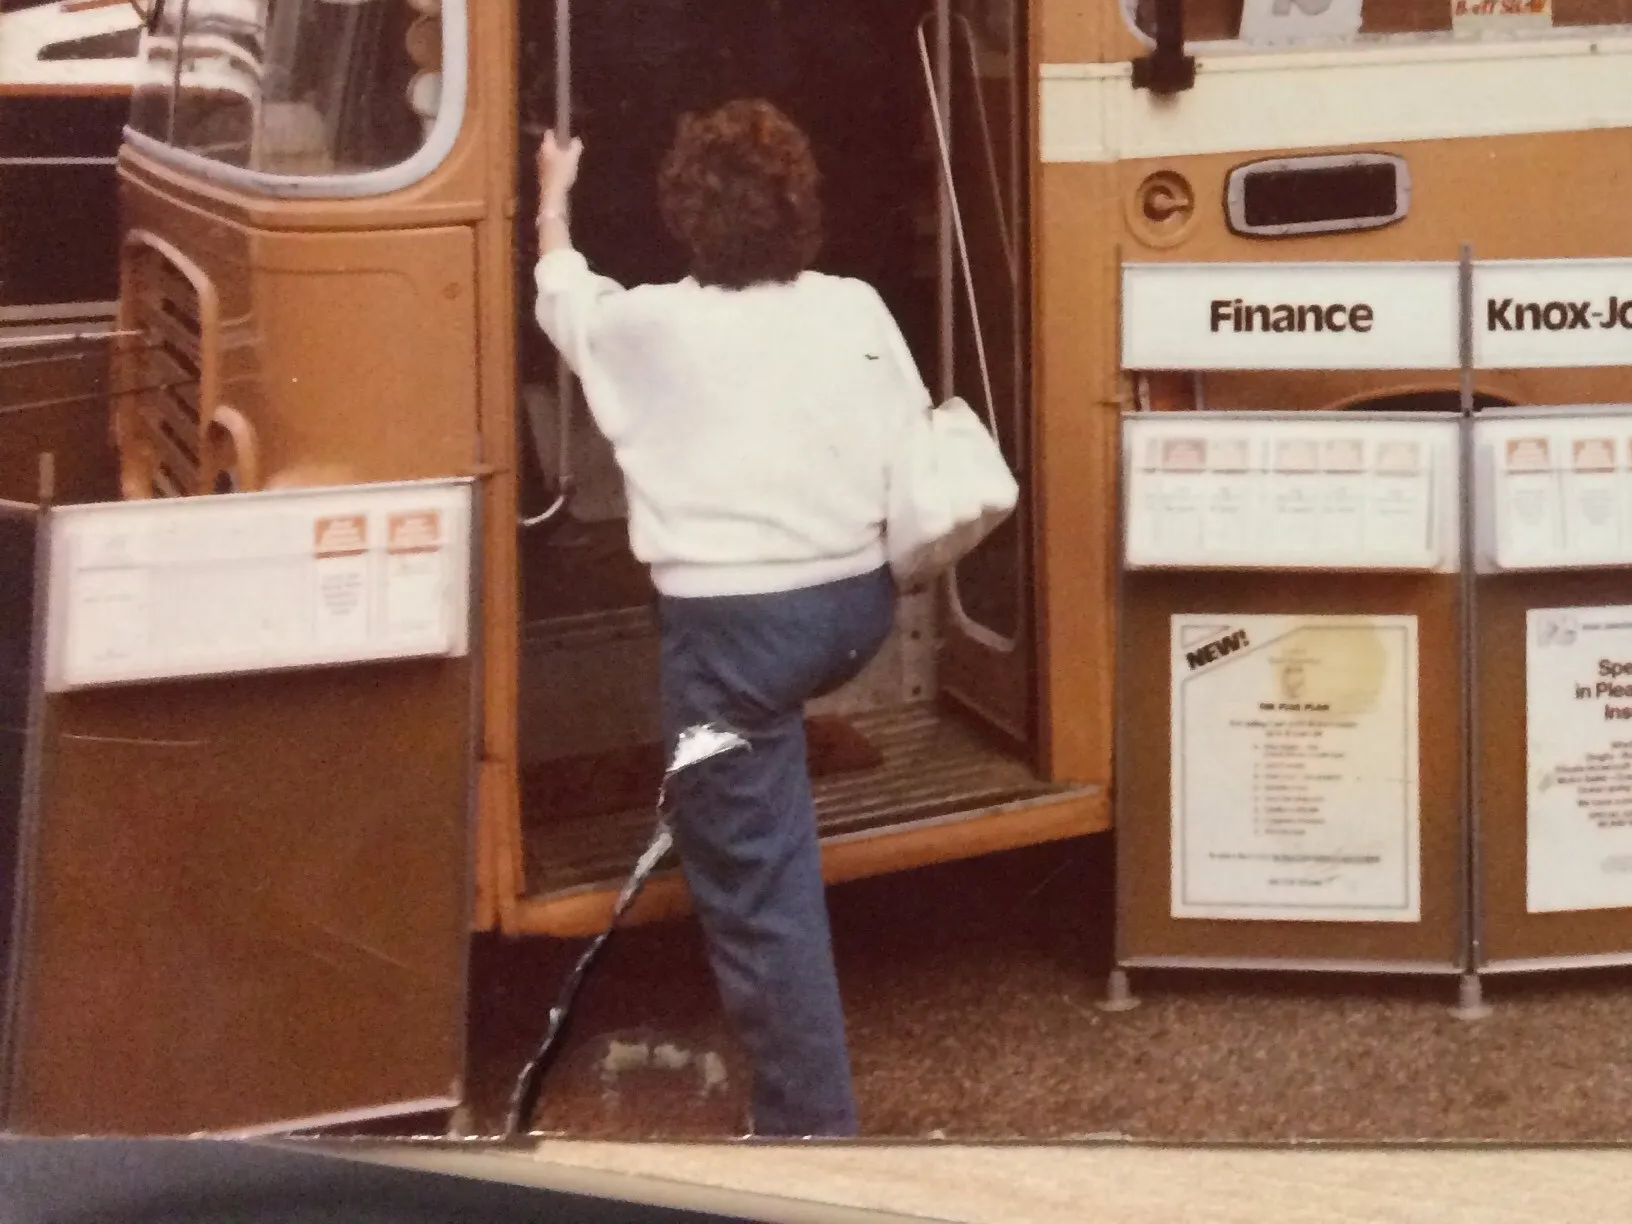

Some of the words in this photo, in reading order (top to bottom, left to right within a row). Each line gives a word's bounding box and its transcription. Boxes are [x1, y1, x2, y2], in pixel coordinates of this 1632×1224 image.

[1210, 298, 1374, 333] Finance
[1186, 629, 1249, 670] NEW!
[1575, 684, 1592, 700] in
